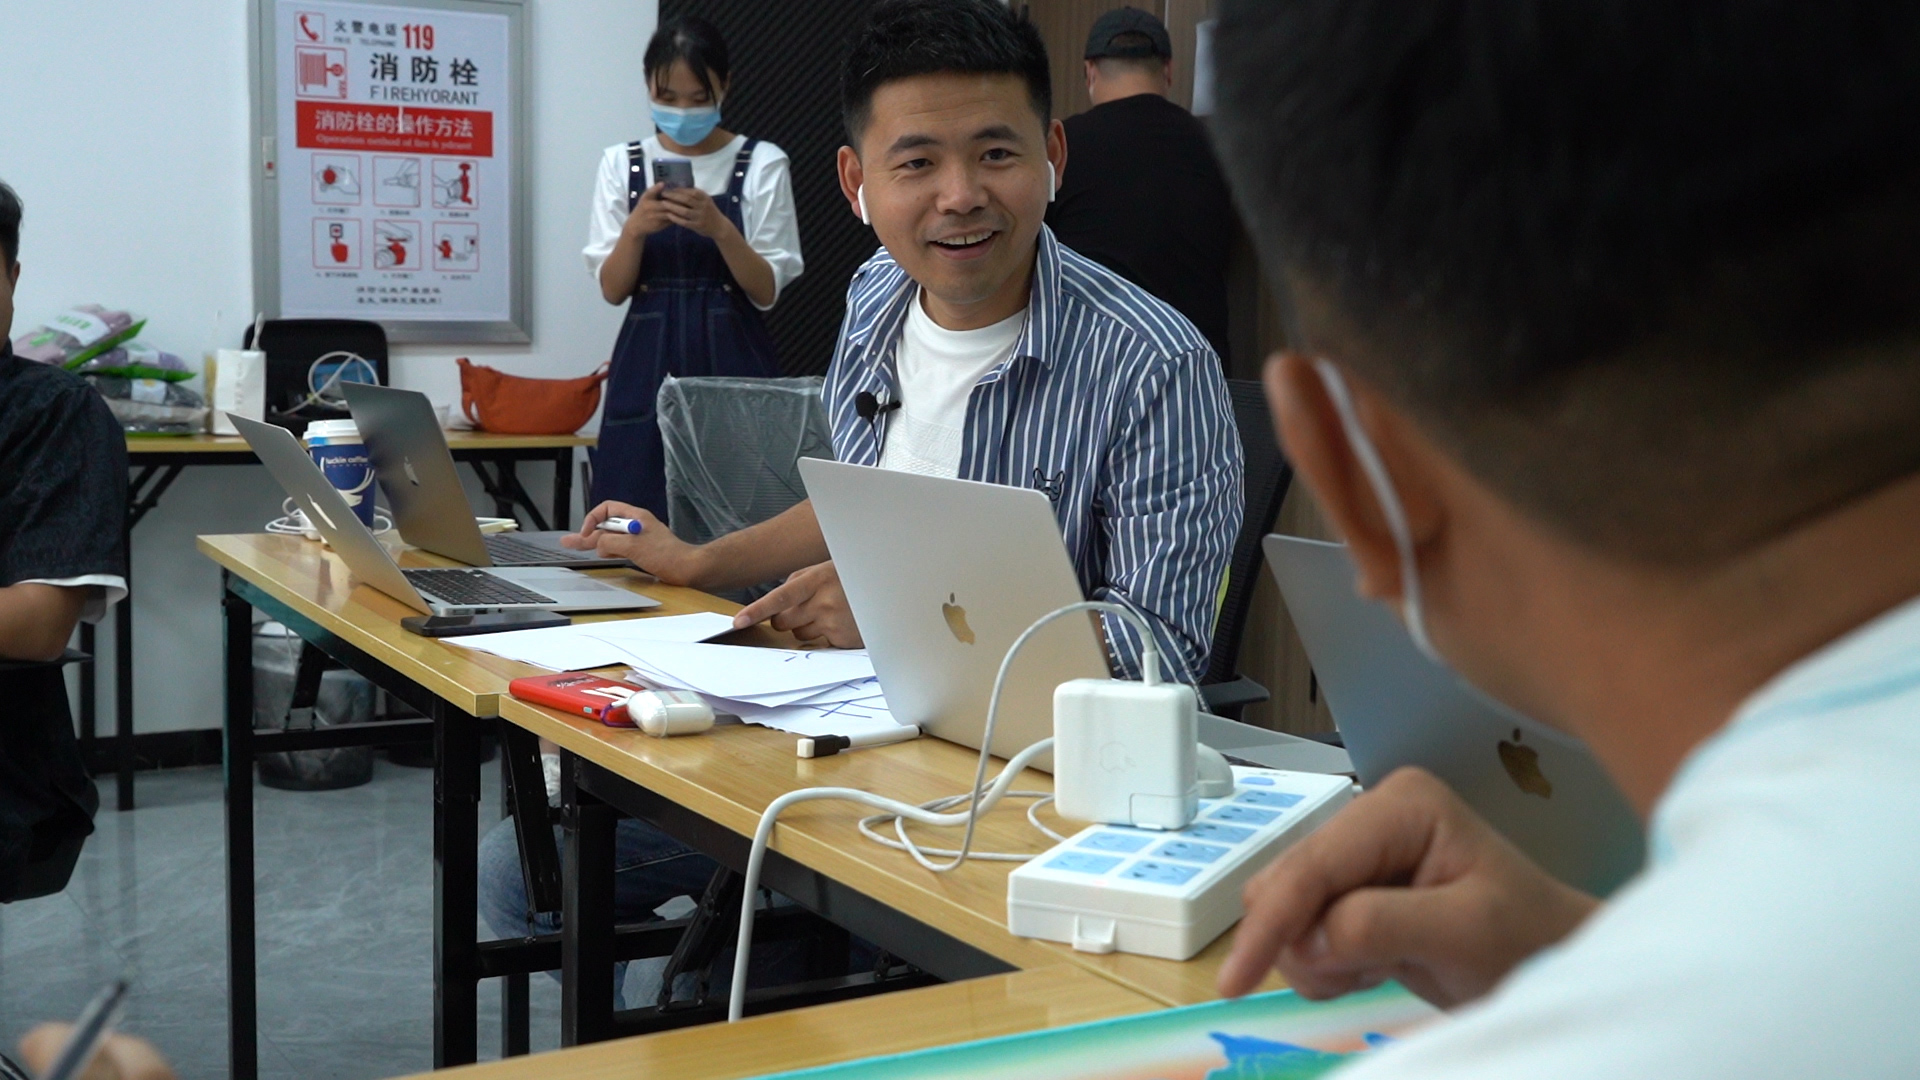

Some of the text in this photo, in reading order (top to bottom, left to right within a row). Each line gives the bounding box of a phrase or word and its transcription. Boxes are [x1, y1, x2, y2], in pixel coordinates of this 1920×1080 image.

[334, 19, 434, 50] 火警电话 119
[370, 52, 478, 86] 消防栓
[315, 108, 474, 138] 消防栓的操作方法
